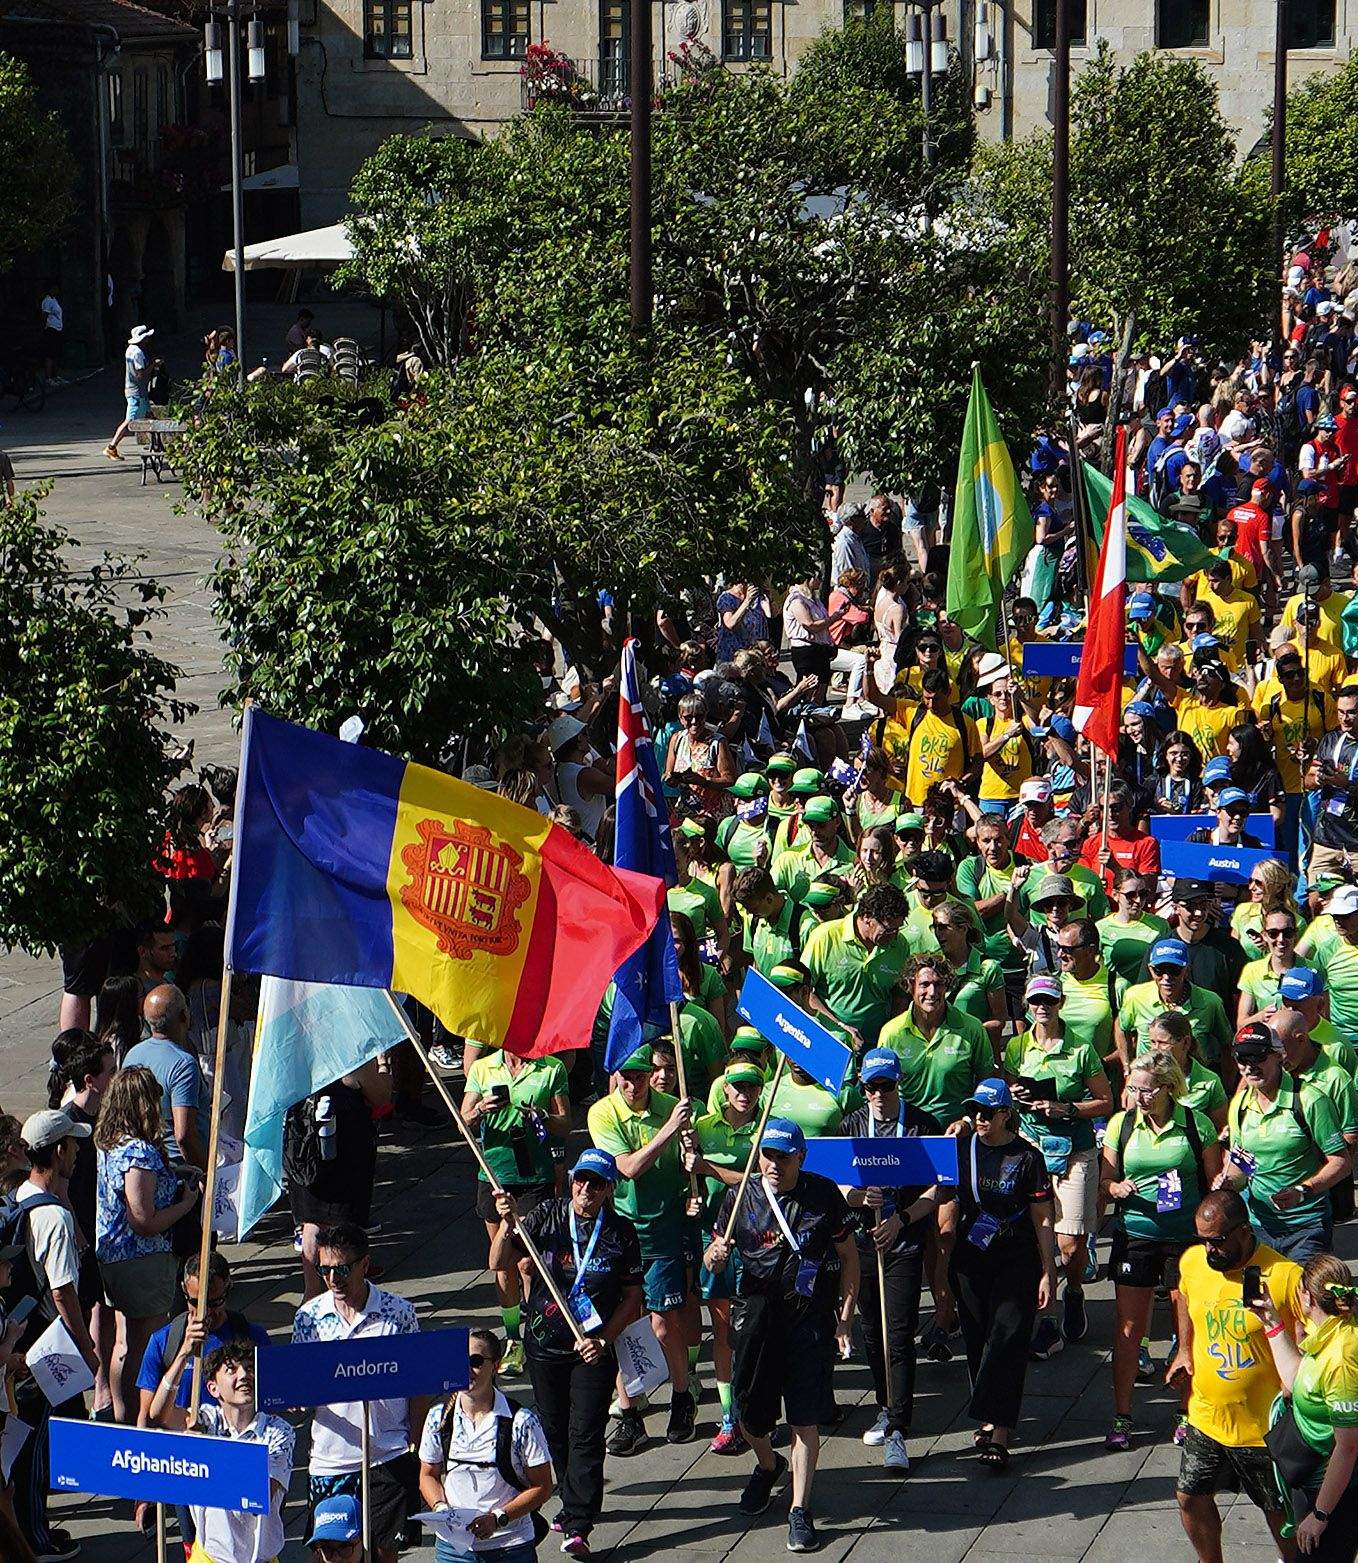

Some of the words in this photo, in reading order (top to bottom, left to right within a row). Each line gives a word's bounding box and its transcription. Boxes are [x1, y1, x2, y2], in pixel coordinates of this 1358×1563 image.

[1208, 857, 1240, 870] Austria
[775, 1012, 813, 1049] Argentina
[852, 1154, 900, 1167] Australia
[664, 1294, 683, 1306] AUS
[1207, 1343, 1256, 1370] SIL
[334, 1359, 399, 1379] Andorra
[111, 1450, 210, 1478] Afghanistan
